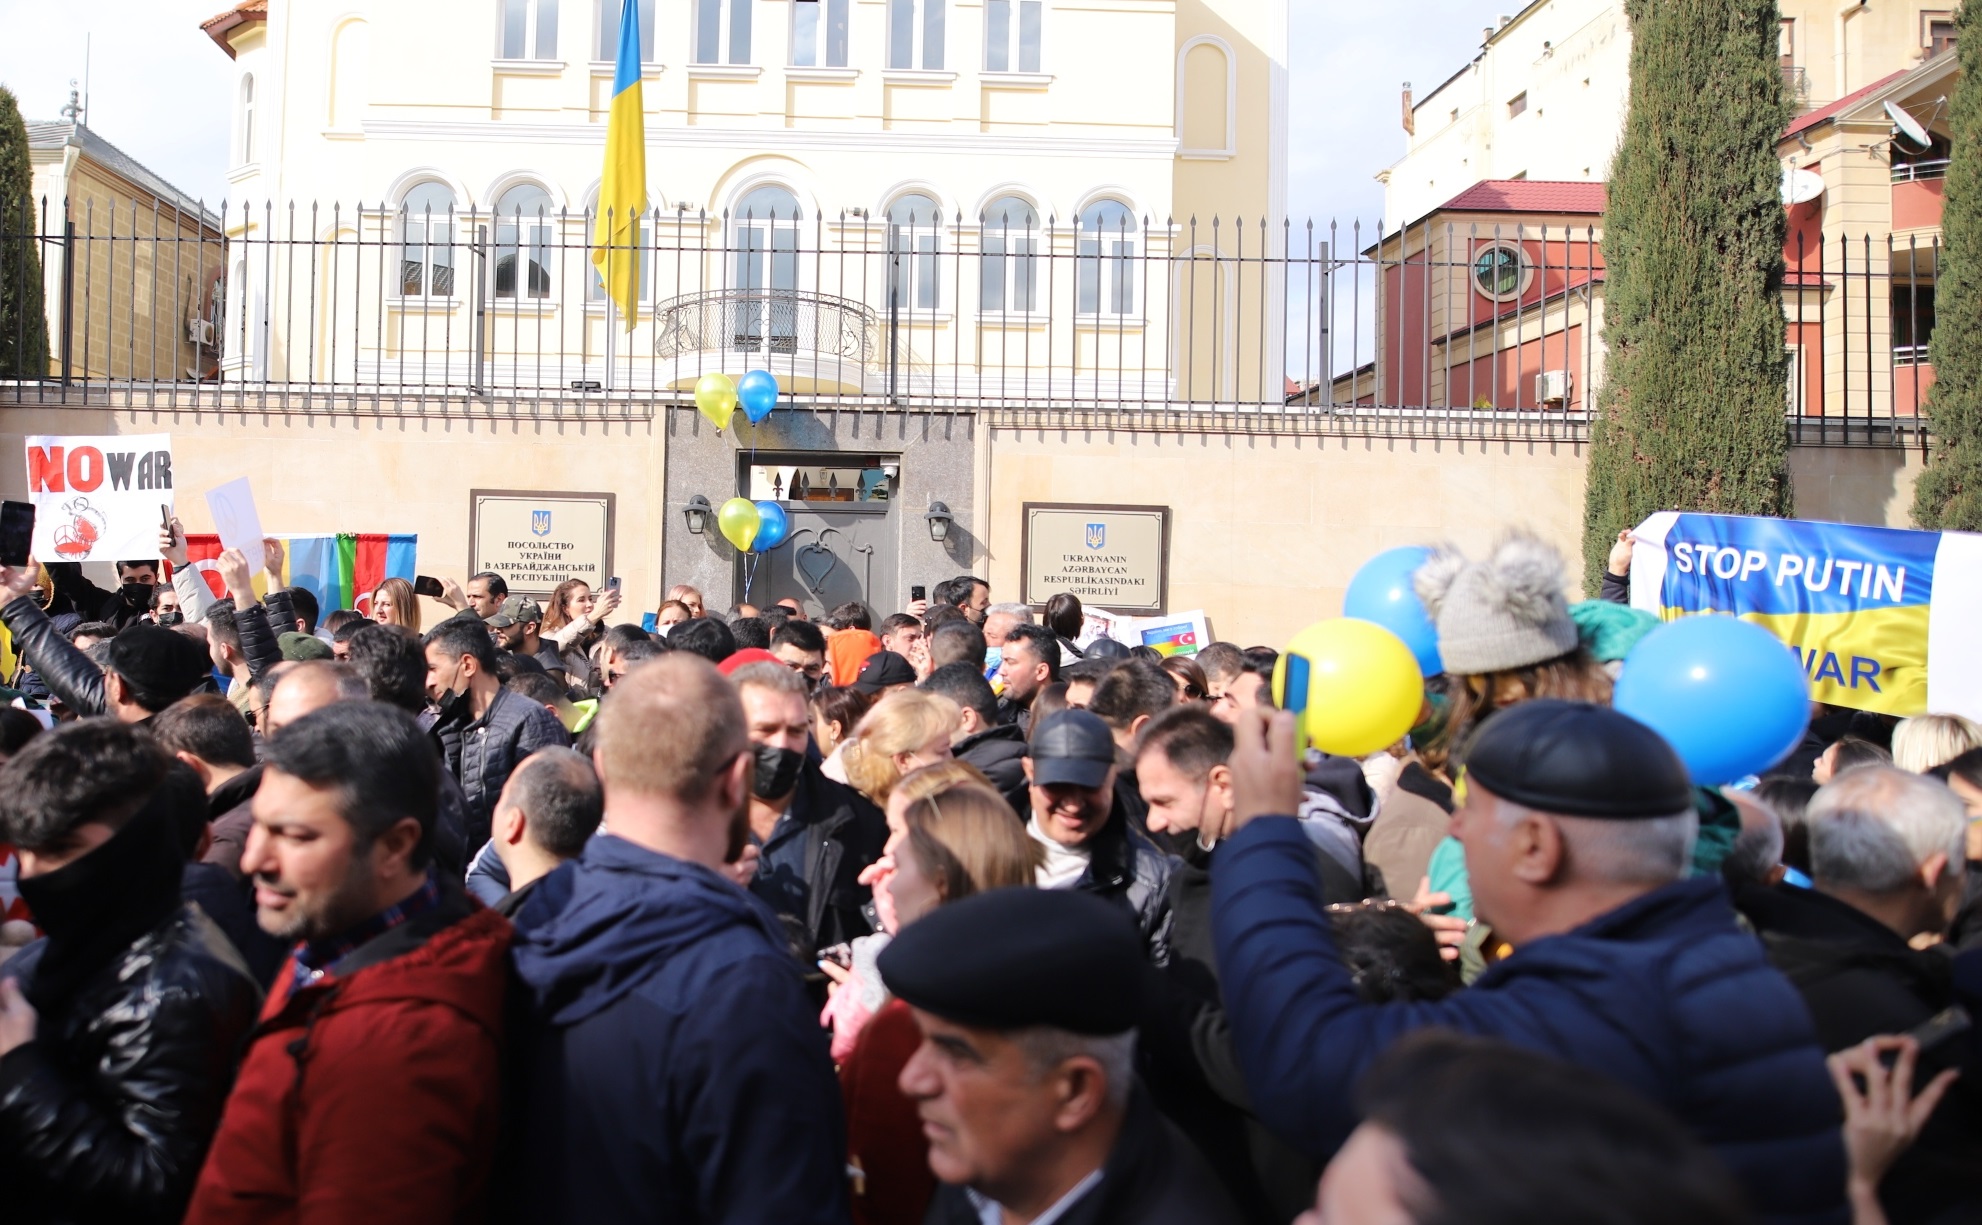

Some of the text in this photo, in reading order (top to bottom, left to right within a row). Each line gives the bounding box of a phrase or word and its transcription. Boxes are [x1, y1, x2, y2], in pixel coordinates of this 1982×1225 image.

[28, 446, 172, 492] NO WAR
[507, 541, 574, 550] ПОСОЛЬСТВО
[519, 552, 562, 561] УКРАЇНИ
[1063, 554, 1127, 563] UKRAYNANIN
[494, 562, 595, 572] АЗЕРБАЙДЖАНСЬКІЙ
[1062, 565, 1127, 574] AZƏRBAYCAN
[1673, 542, 1906, 602] STOP PUTIN
[1069, 586, 1118, 595] SƏFİRLİYİ
